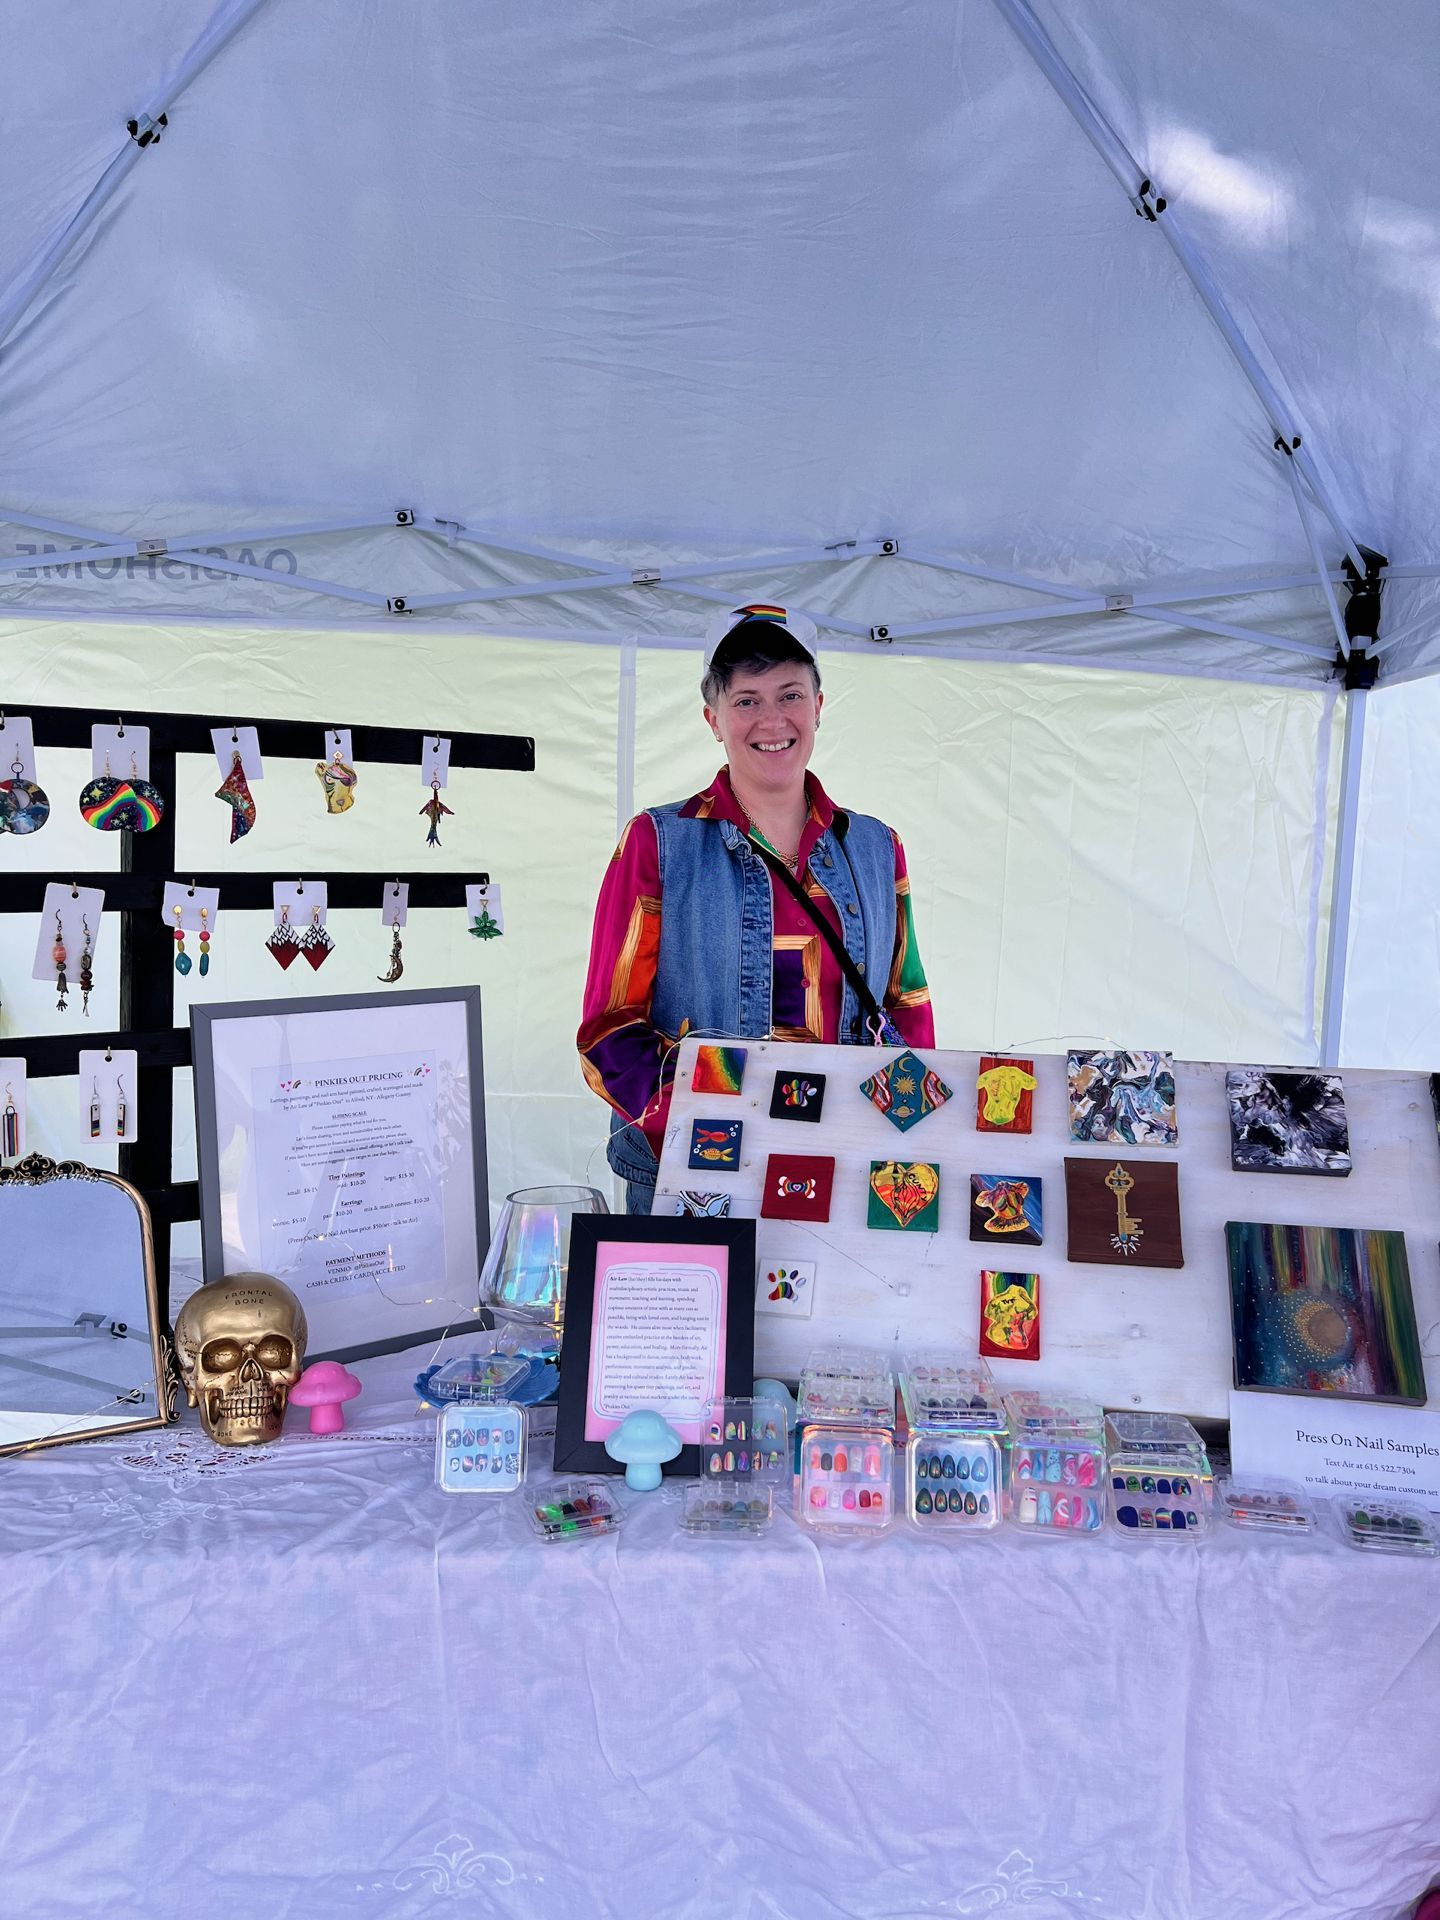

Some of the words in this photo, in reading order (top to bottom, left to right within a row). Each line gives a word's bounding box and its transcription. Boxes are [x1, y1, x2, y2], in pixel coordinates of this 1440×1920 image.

[315, 1077, 348, 1087] PINKIES
[349, 1076, 366, 1084] OUT
[369, 1072, 403, 1081] PRICING
[328, 1174, 341, 1182] Tiny
[342, 1171, 366, 1179] Paintings
[350, 1179, 367, 1187] $10-20
[325, 1255, 356, 1266] PAYMENT
[356, 1250, 387, 1260] METHODS
[306, 1279, 323, 1289] CASH
[330, 1274, 353, 1284] CREDIT
[374, 1264, 406, 1276] ACCETED
[225, 1289, 274, 1300] FRONTAL
[234, 1298, 264, 1306] BONE
[1296, 1430, 1328, 1444] Press
[1331, 1433, 1352, 1447] On
[1356, 1436, 1384, 1450] Nail
[1387, 1440, 1440, 1458] Samples
[1324, 1458, 1340, 1466] Text
[1342, 1460, 1354, 1468] Air
[1364, 1463, 1416, 1476] 615.522.7304
[1315, 1476, 1329, 1484] talk
[1330, 1478, 1352, 1487] about
[1354, 1482, 1371, 1490] your
[1372, 1482, 1397, 1492] dream
[1398, 1486, 1427, 1495] custom
